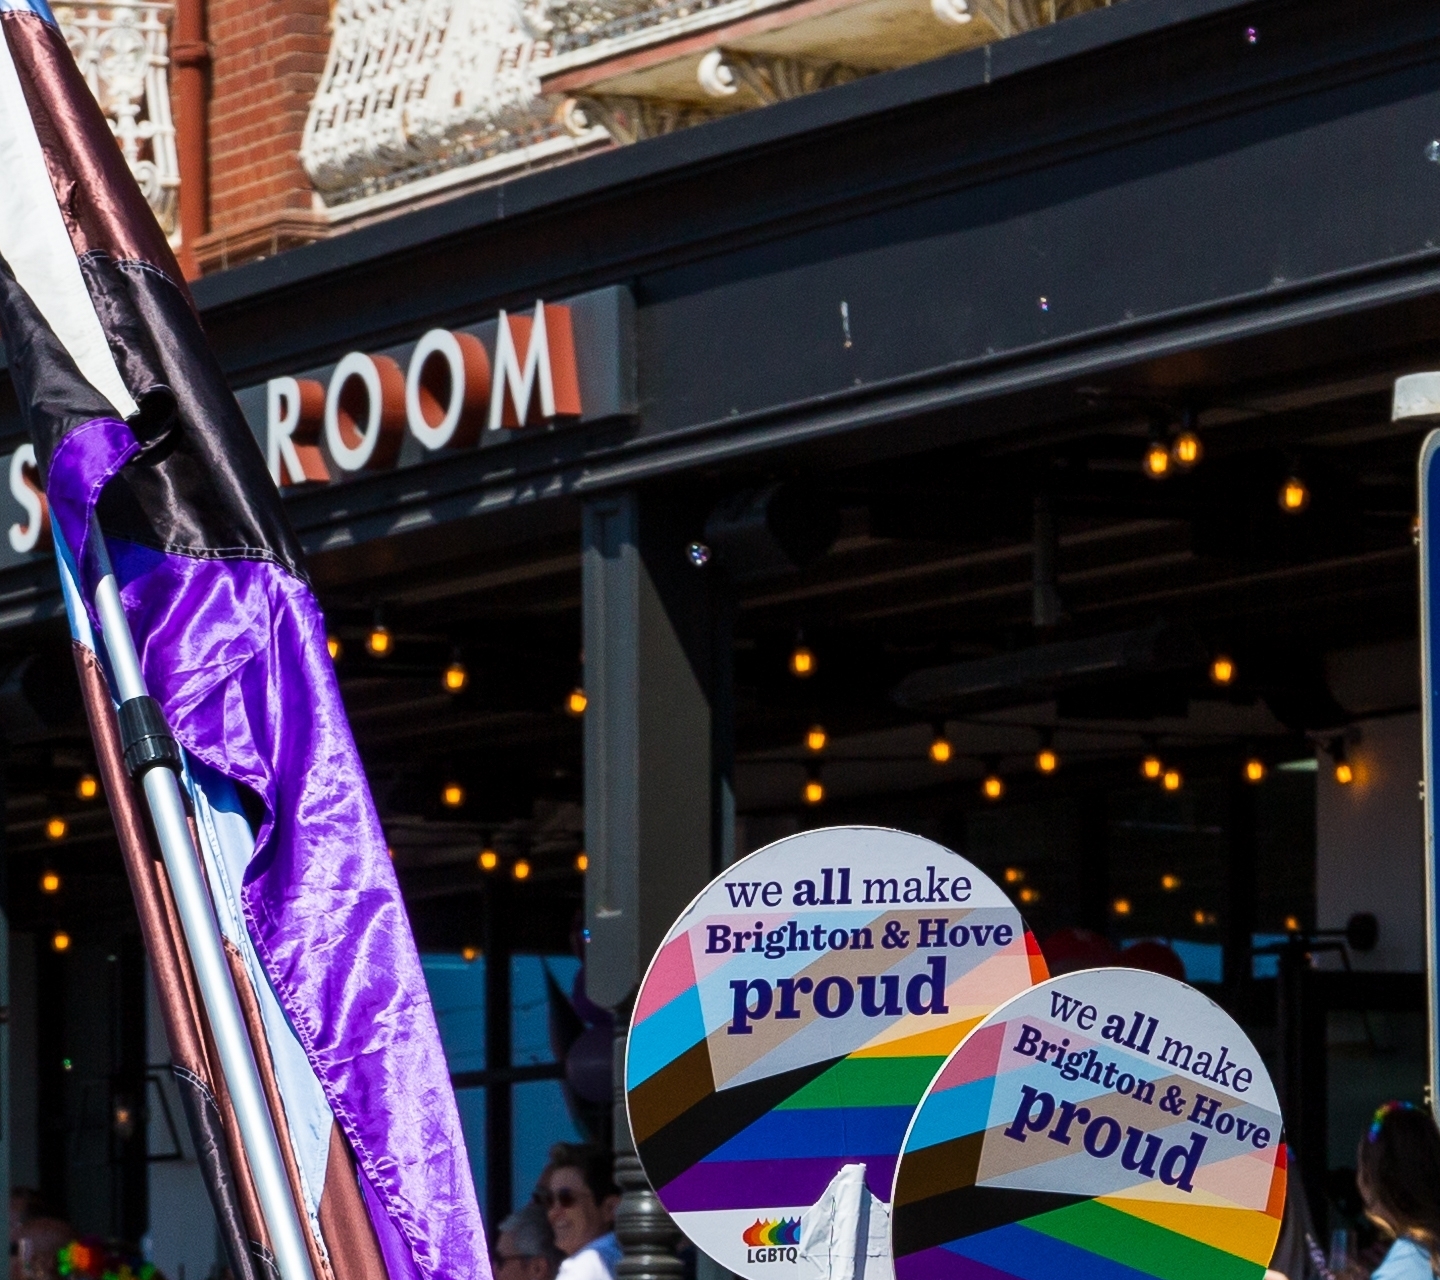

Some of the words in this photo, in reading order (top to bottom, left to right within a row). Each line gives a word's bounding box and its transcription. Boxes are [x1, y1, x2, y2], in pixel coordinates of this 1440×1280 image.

[267, 299, 558, 485] ROOM
[725, 881, 783, 908] we
[793, 868, 853, 907] all
[861, 866, 972, 904] make
[705, 921, 874, 960] Brighton
[881, 922, 910, 950] &
[916, 918, 1013, 949] Hove
[727, 955, 949, 1035] proud
[1012, 1023, 1157, 1106] Brighton
[1158, 1085, 1187, 1116] &
[1187, 1093, 1271, 1150] Hove
[1049, 990, 1098, 1031] we
[1100, 1011, 1159, 1056] all
[1157, 1046, 1253, 1093] make
[1003, 1084, 1209, 1193] proud
[747, 1247, 797, 1264] LGBTQ
